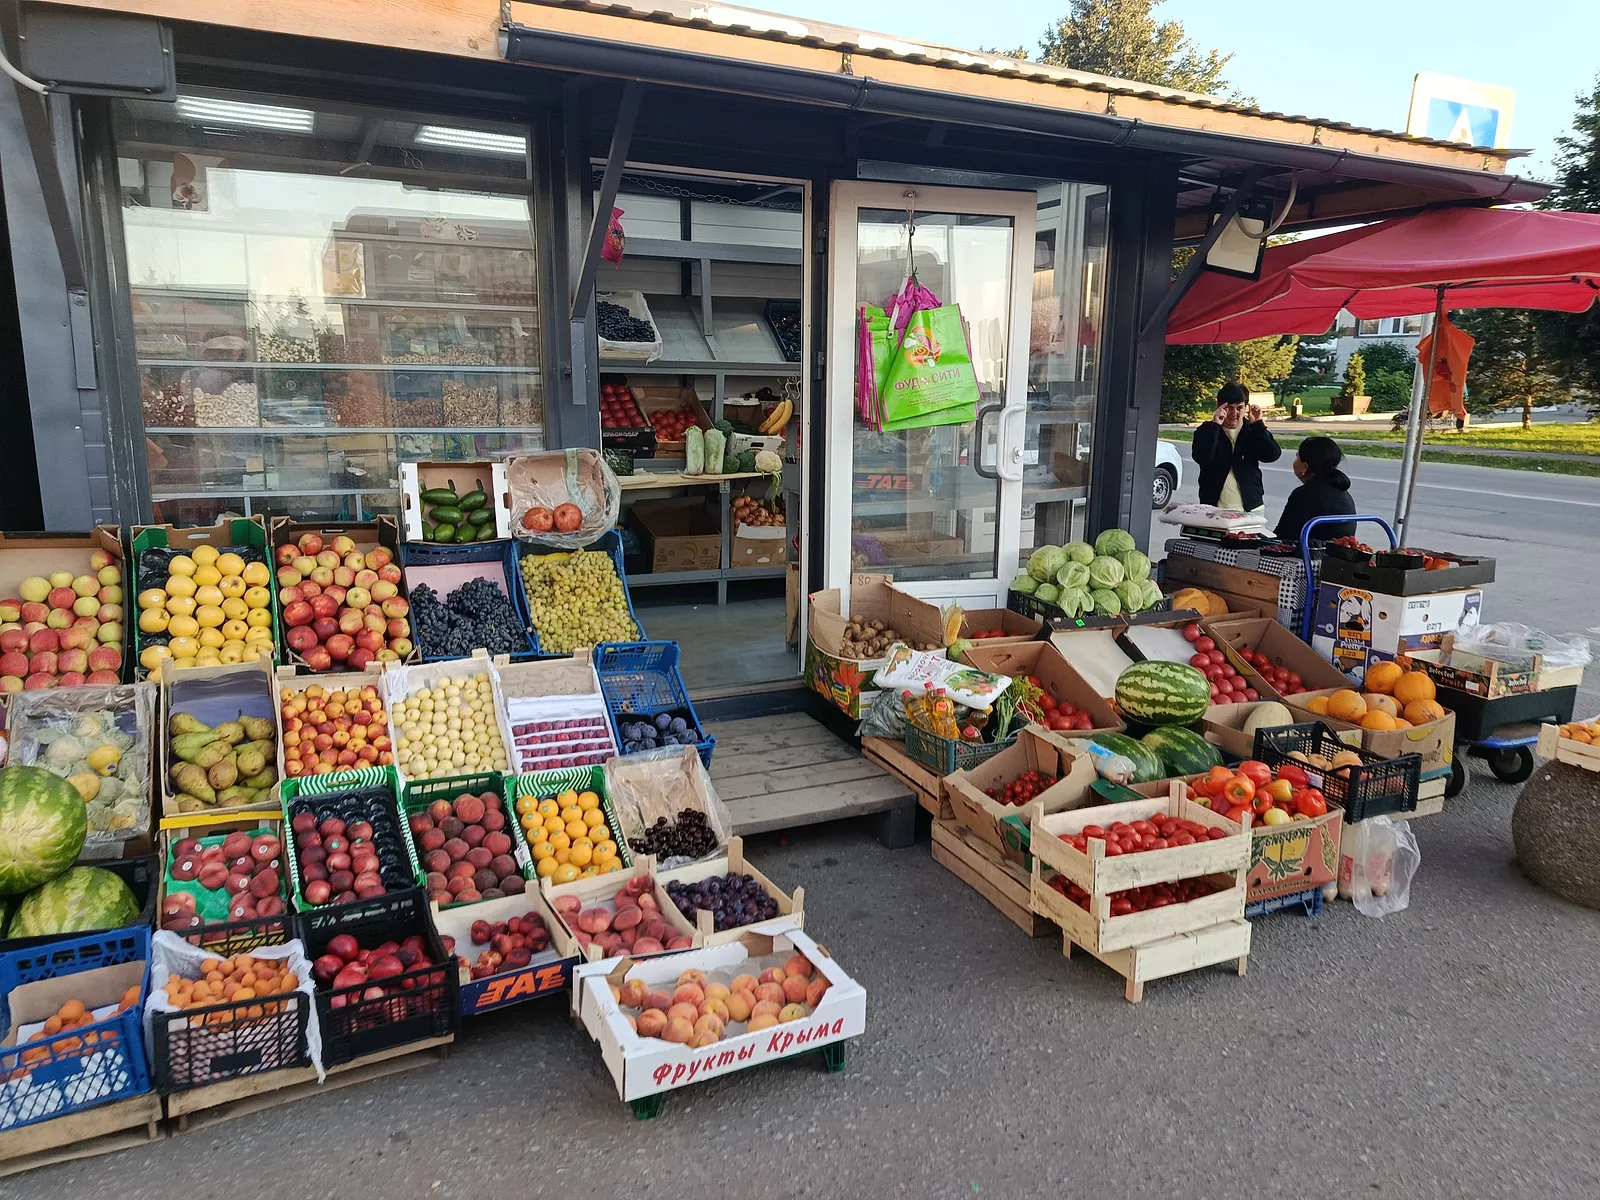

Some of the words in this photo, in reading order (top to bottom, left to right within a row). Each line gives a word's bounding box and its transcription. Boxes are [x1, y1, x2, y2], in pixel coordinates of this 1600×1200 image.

[895, 377, 920, 391] ФУД
[931, 367, 960, 383] СИТИ
[858, 574, 871, 586] 80
[1428, 666, 1454, 679] Selected
[1440, 676, 1464, 688] Fruits
[477, 965, 565, 1006] TAT
[653, 1044, 755, 1086] Фрукты
[767, 1017, 844, 1053] Крыма
